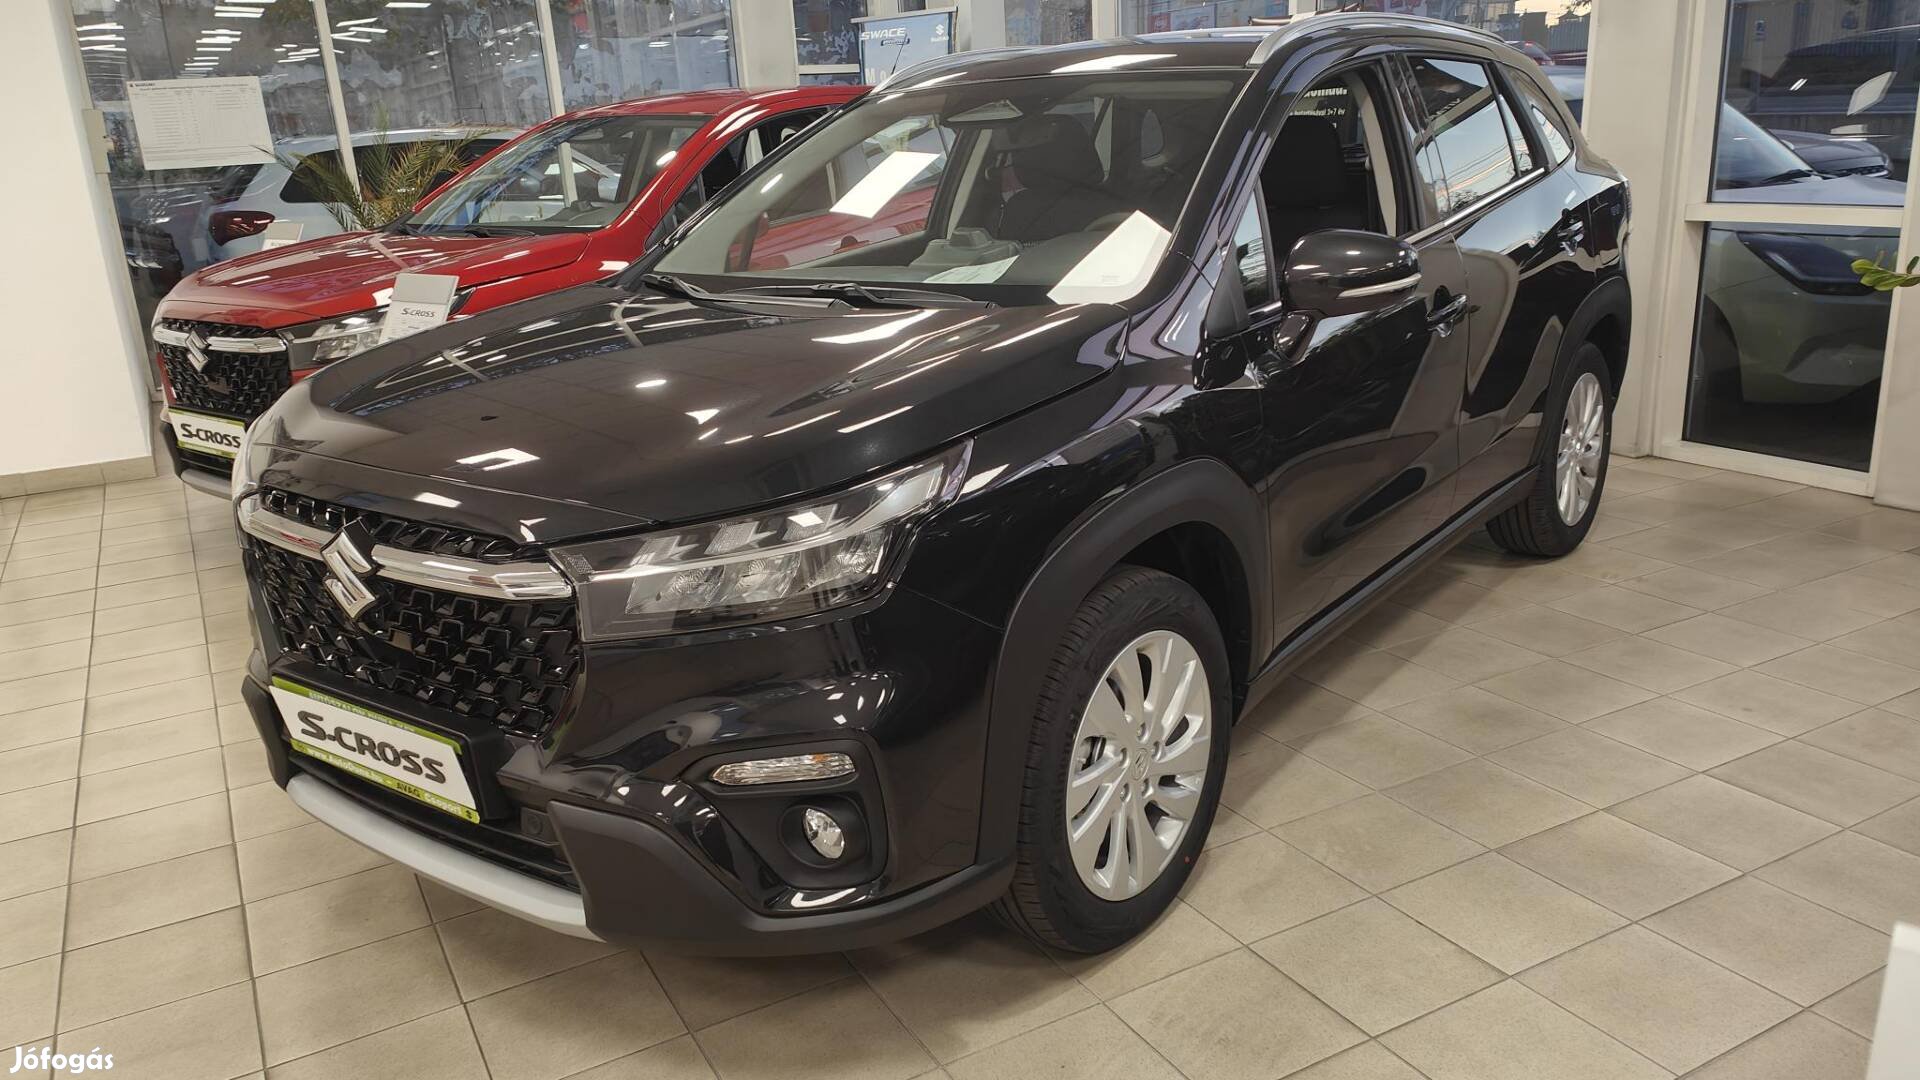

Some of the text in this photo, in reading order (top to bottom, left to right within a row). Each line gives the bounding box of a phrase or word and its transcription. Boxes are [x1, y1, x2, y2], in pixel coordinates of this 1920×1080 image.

[860, 27, 906, 40] SWACE
[401, 308, 435, 318] S-CROSS
[180, 423, 241, 448] S-CROSS
[297, 710, 446, 784] S-CROSS
